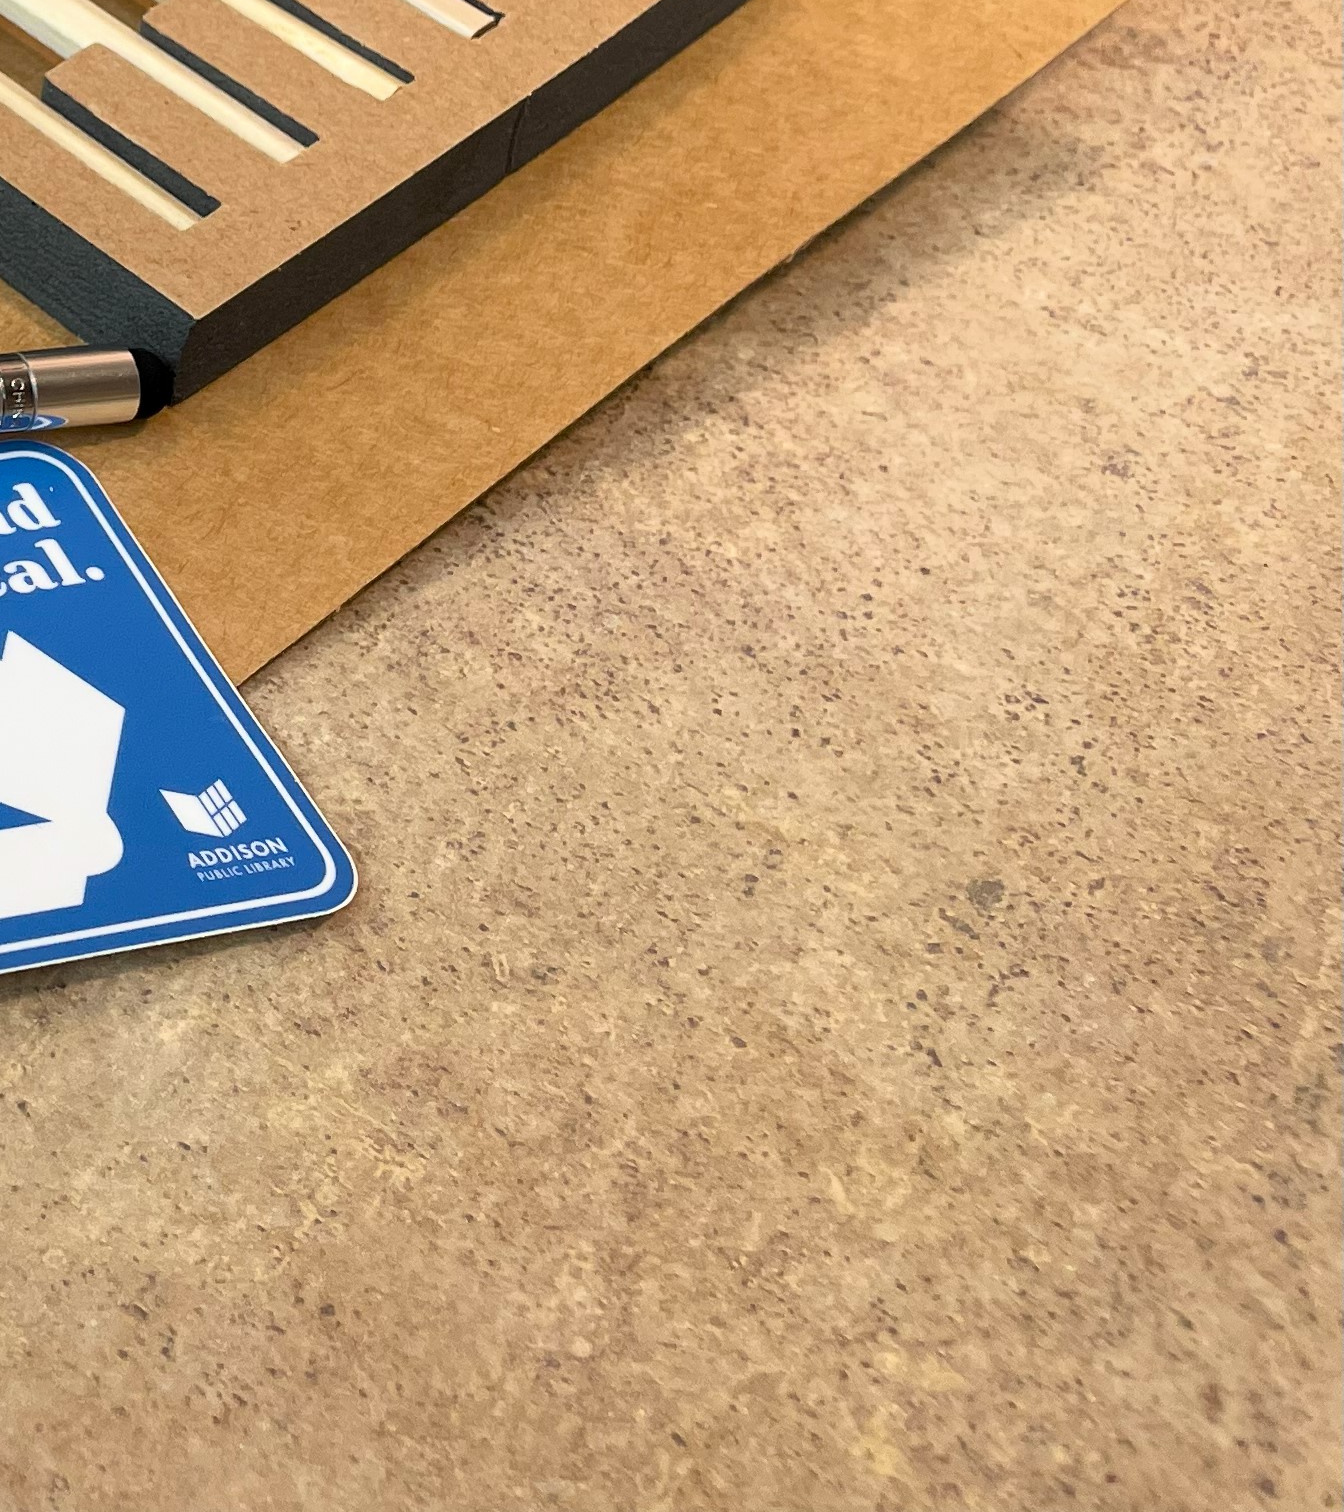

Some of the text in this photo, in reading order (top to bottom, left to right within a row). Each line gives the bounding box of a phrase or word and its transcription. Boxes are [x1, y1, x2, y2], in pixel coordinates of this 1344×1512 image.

[10, 377, 26, 425] CHIN
[187, 837, 289, 870] ADDISON
[198, 856, 295, 882] PUBLIC LIBRARY
